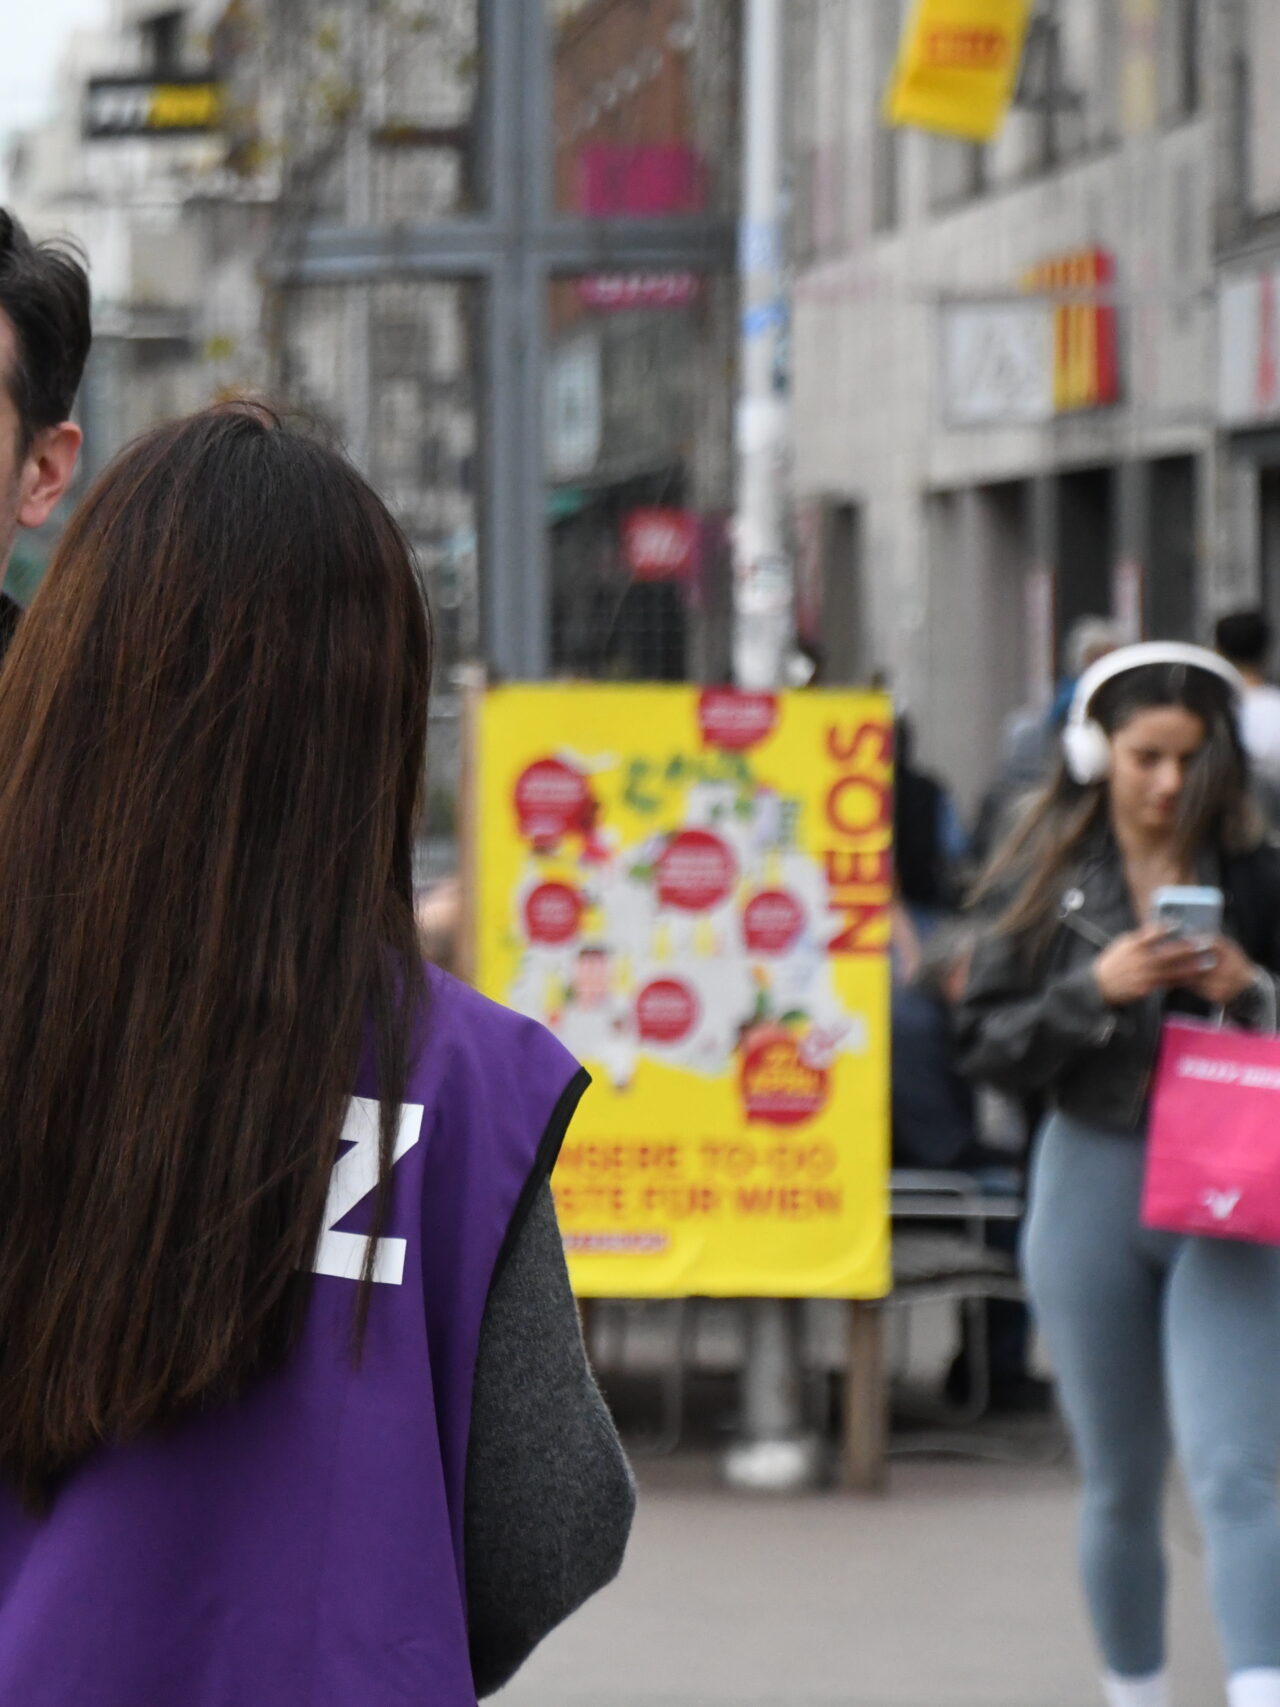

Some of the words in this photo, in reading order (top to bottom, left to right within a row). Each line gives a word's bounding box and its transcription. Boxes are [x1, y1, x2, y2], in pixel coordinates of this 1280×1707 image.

[825, 721, 891, 956] NEOS
[313, 1096, 424, 1285] Z
[556, 1141, 681, 1177] NSERE
[734, 1183, 843, 1218] WIEN
